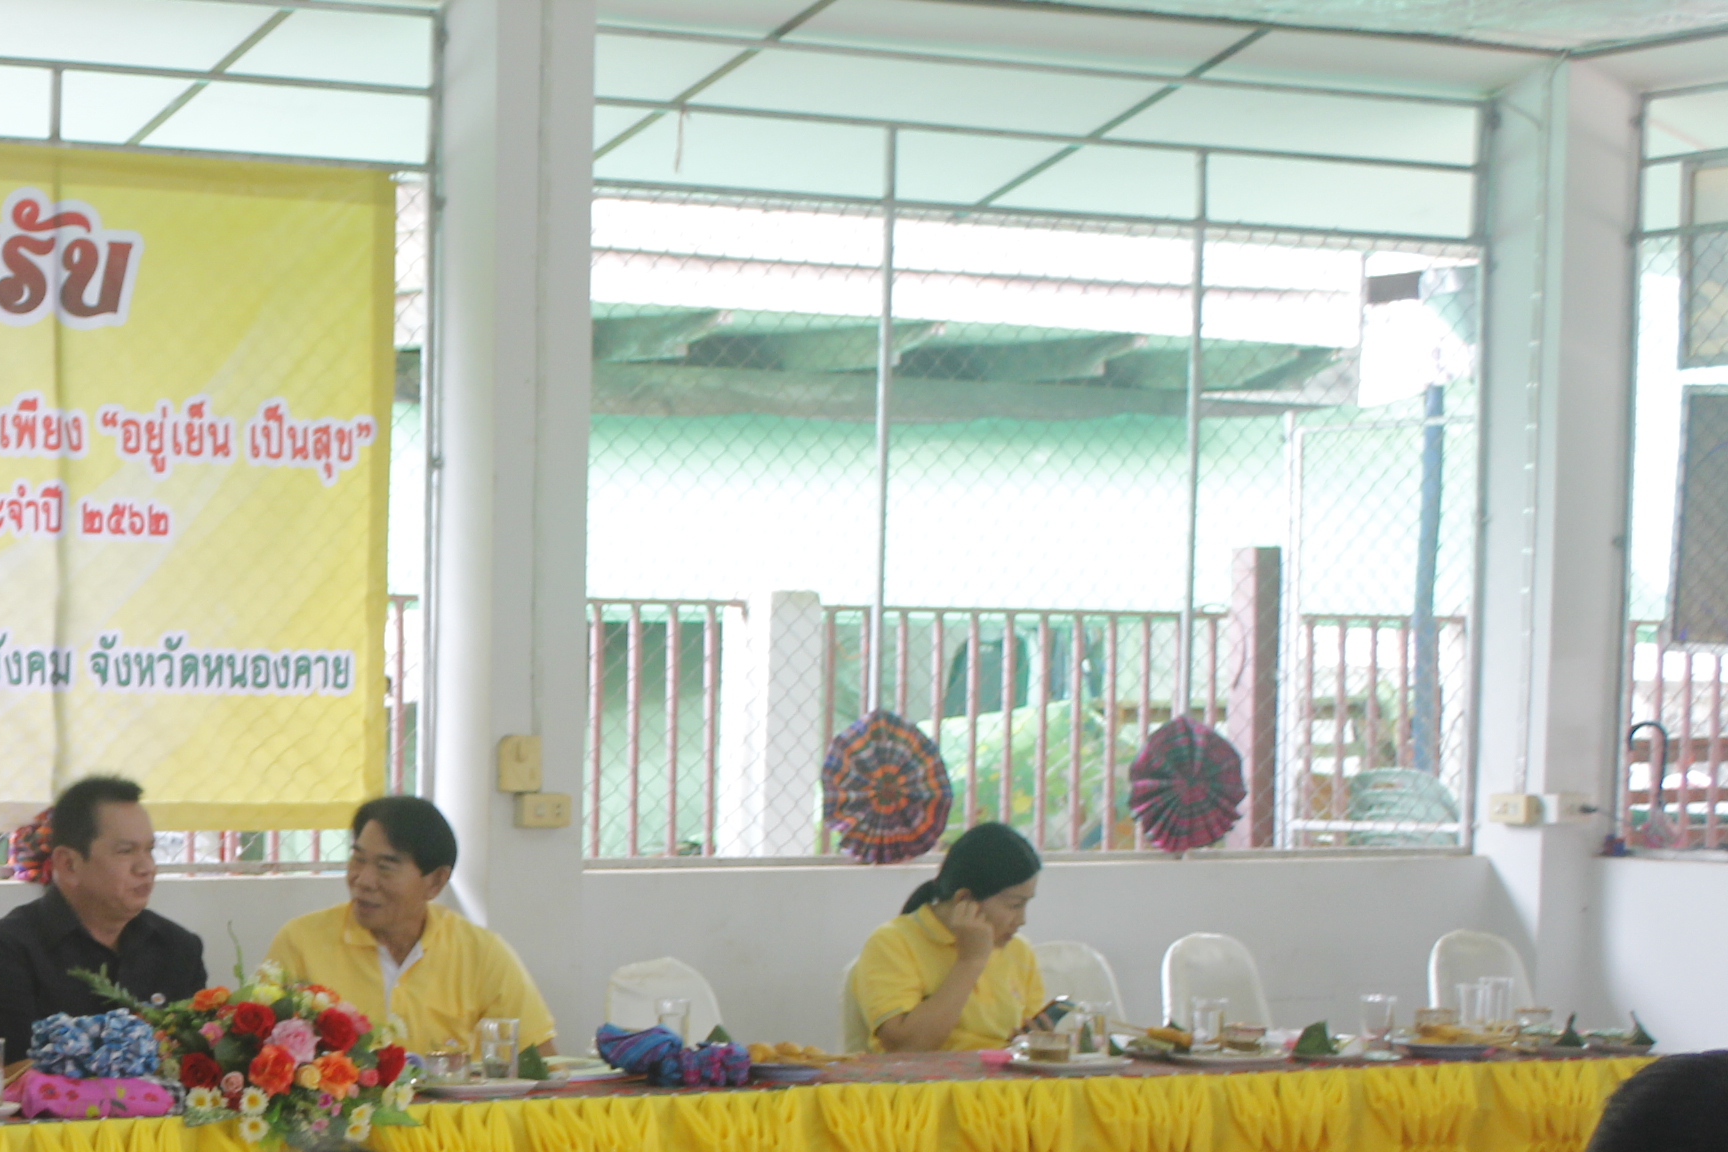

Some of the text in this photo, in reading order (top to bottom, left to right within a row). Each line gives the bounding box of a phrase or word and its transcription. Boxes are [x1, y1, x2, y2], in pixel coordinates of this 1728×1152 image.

[81, 502, 170, 536] ๒๕๖๒
[90, 634, 352, 690] จังหวัดหนองคาย
